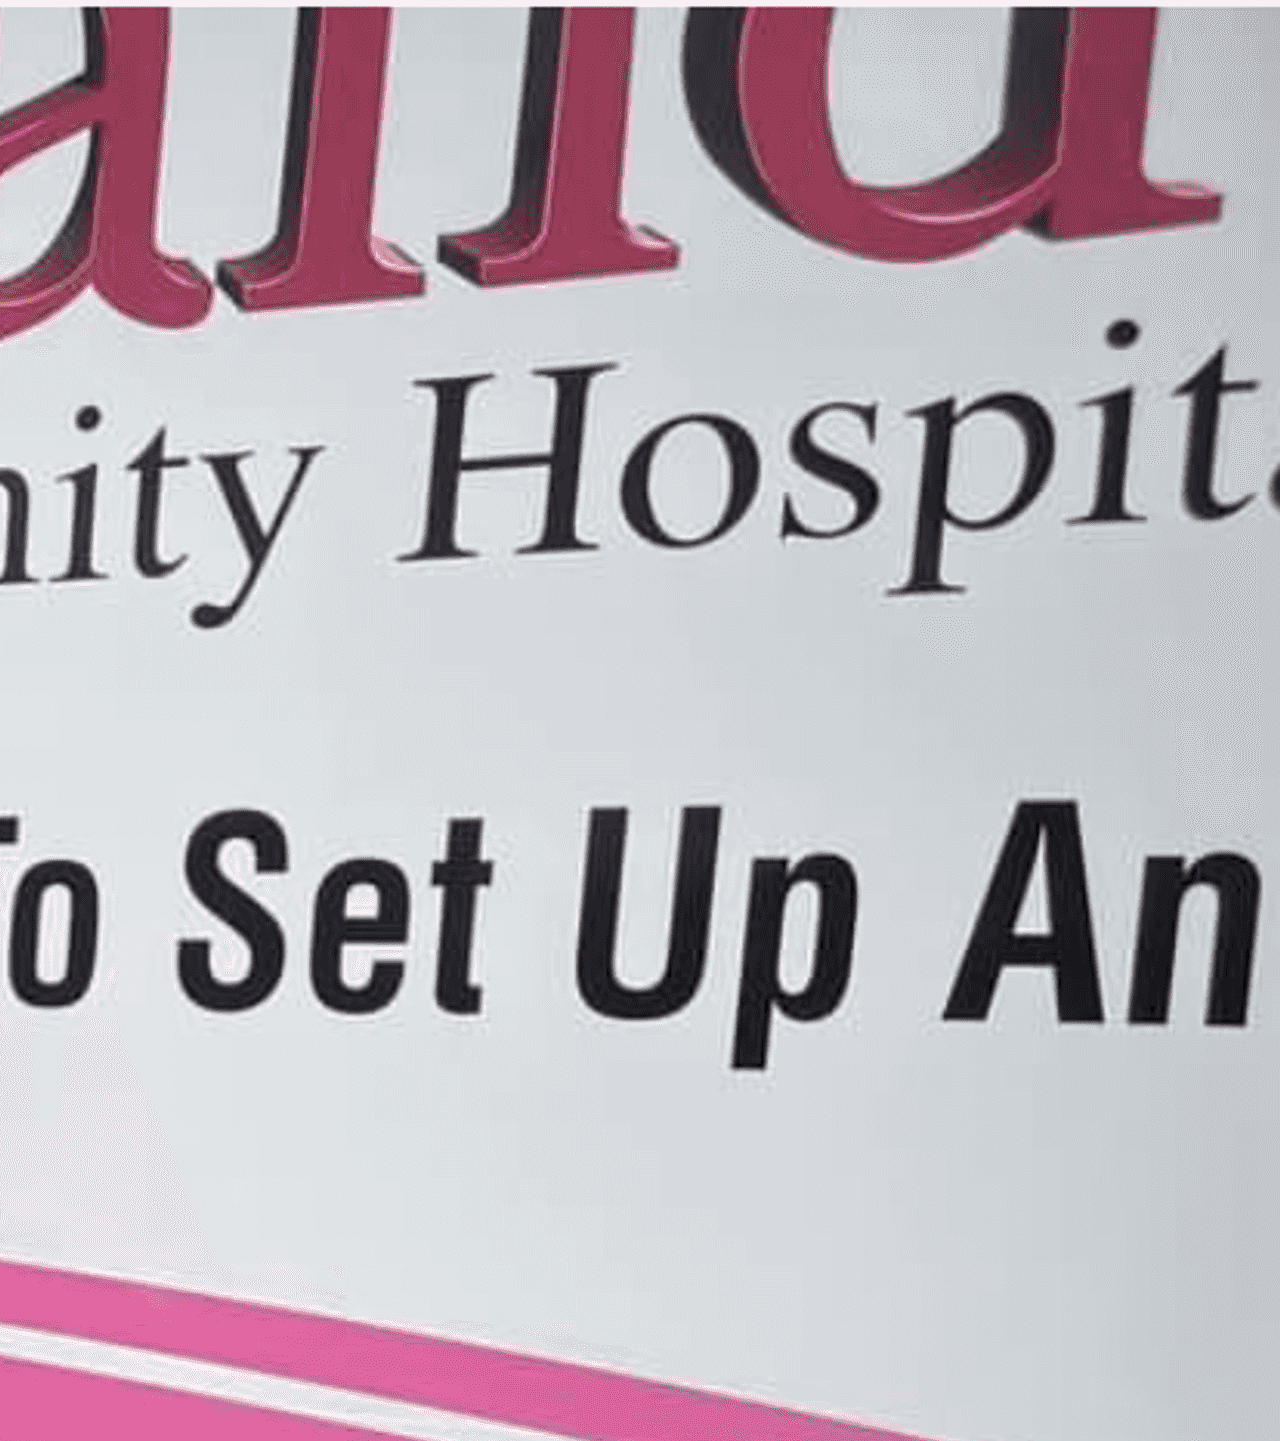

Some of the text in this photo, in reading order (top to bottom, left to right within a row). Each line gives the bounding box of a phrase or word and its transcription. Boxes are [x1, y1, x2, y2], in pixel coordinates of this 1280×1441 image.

[397, 318, 1280, 597] Hospit
[176, 808, 495, 1016] Set
[574, 804, 859, 1072] Up
[940, 798, 1263, 1029] An
